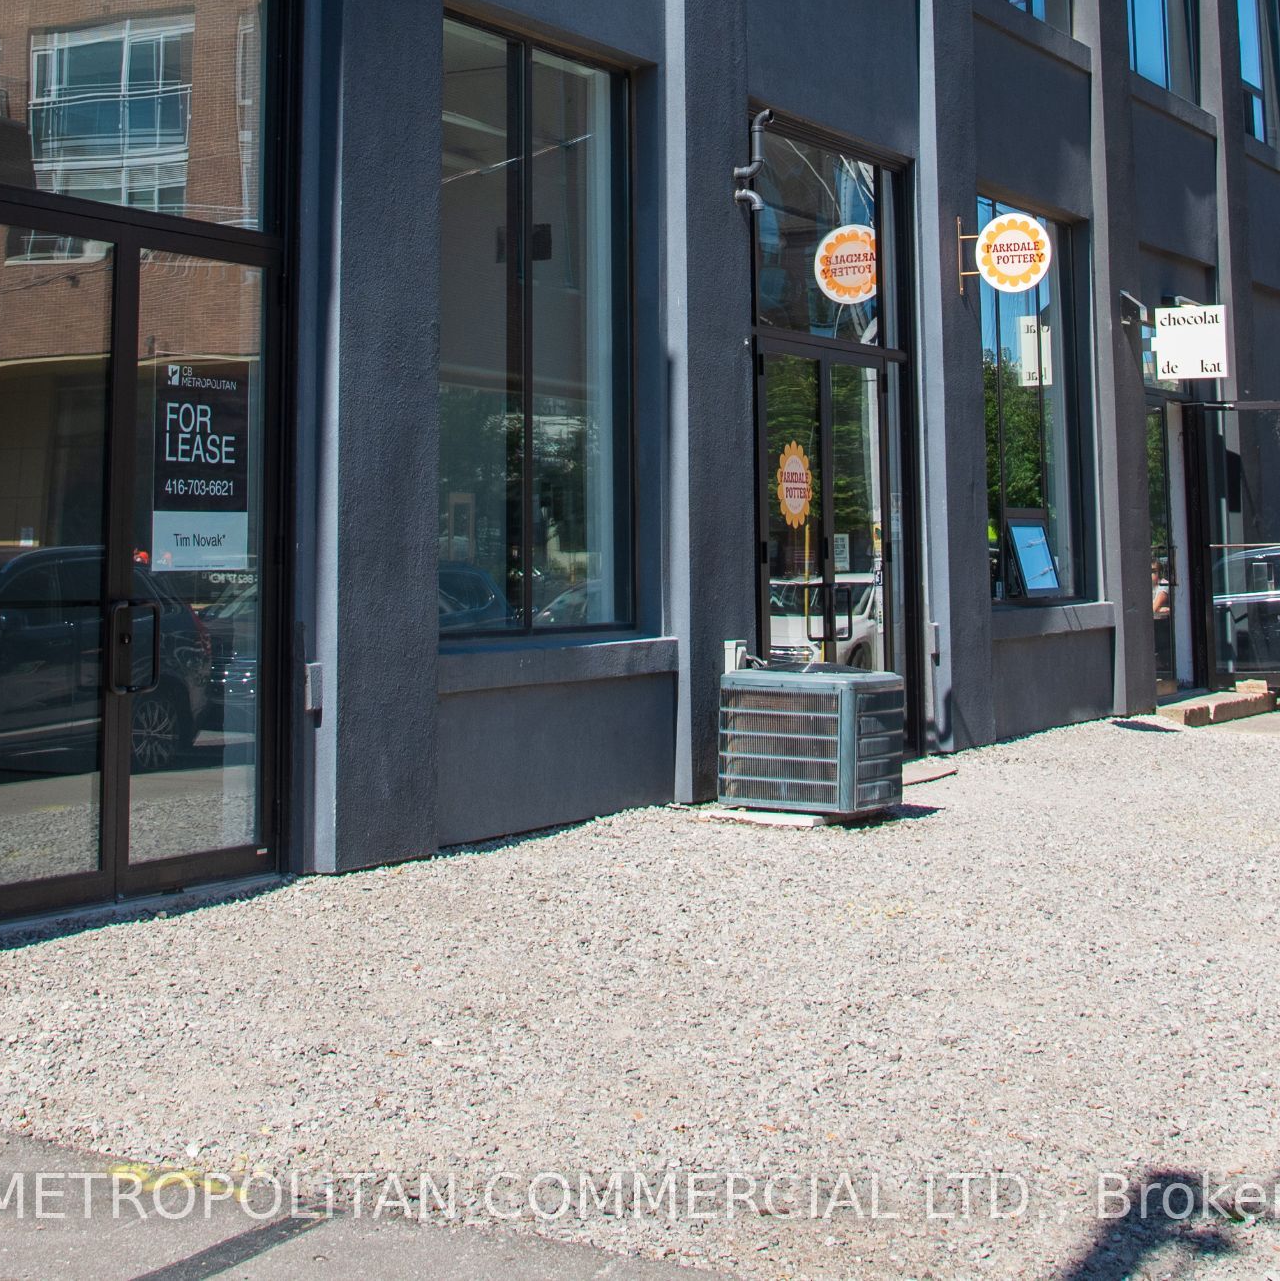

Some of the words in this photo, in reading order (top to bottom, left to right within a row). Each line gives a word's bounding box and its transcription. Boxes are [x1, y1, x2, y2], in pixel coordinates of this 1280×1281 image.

[986, 241, 1040, 253] PARKDALE
[997, 253, 1044, 265] POTTERY
[1160, 311, 1220, 327] chocolat
[182, 366, 193, 376] CB
[1161, 360, 1178, 374] de
[1200, 359, 1222, 373] kat
[181, 377, 237, 390] METROPOLITAN
[166, 402, 211, 433] FOR
[165, 432, 236, 464] LEASE
[780, 471, 809, 484] PARKDALE
[165, 479, 234, 496] 416-703-6621
[785, 487, 811, 499] POTTERY
[173, 533, 191, 547] Tim
